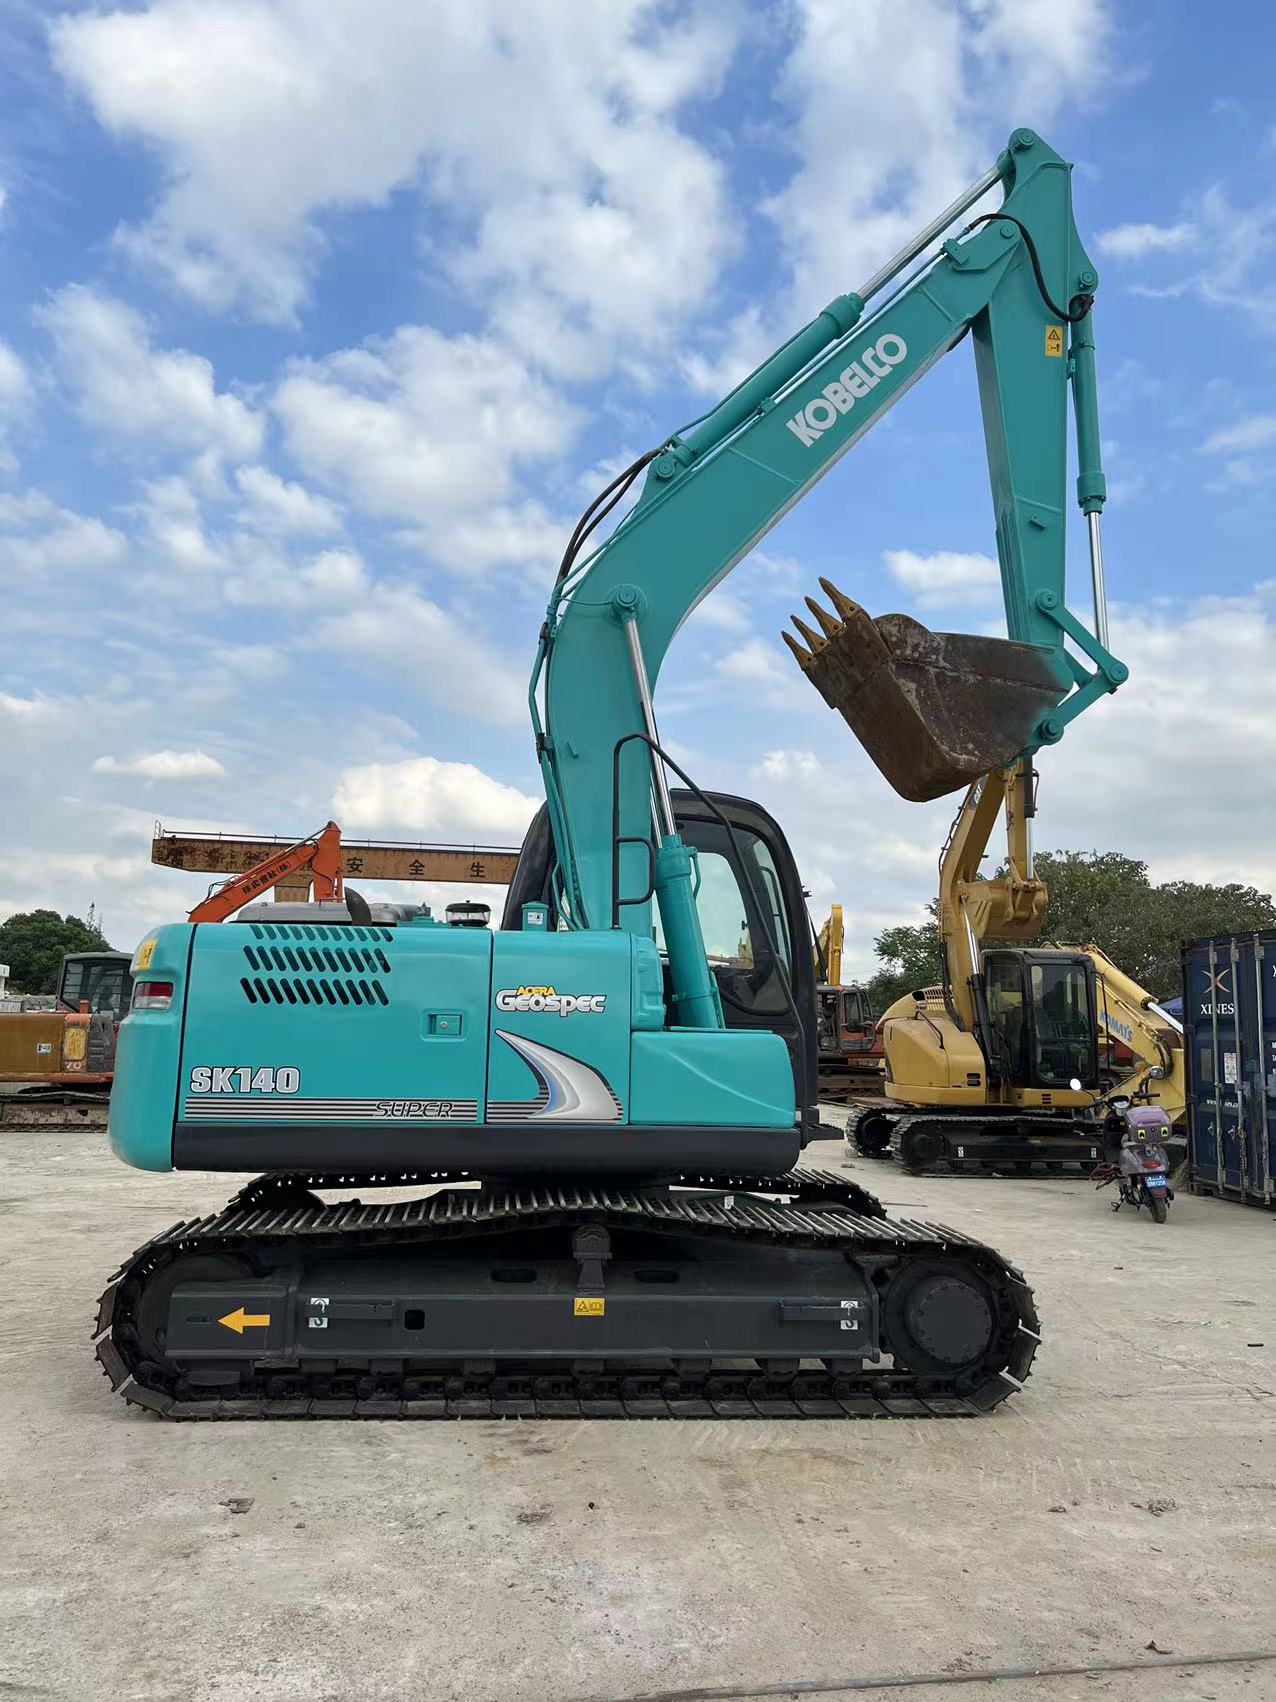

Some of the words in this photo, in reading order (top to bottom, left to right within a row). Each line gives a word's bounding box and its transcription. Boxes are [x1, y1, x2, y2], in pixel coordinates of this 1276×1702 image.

[786, 333, 908, 448] KOBELCO
[517, 986, 556, 996] ACERA
[190, 1066, 301, 1094] SK140
[373, 1101, 454, 1118] SUPER
